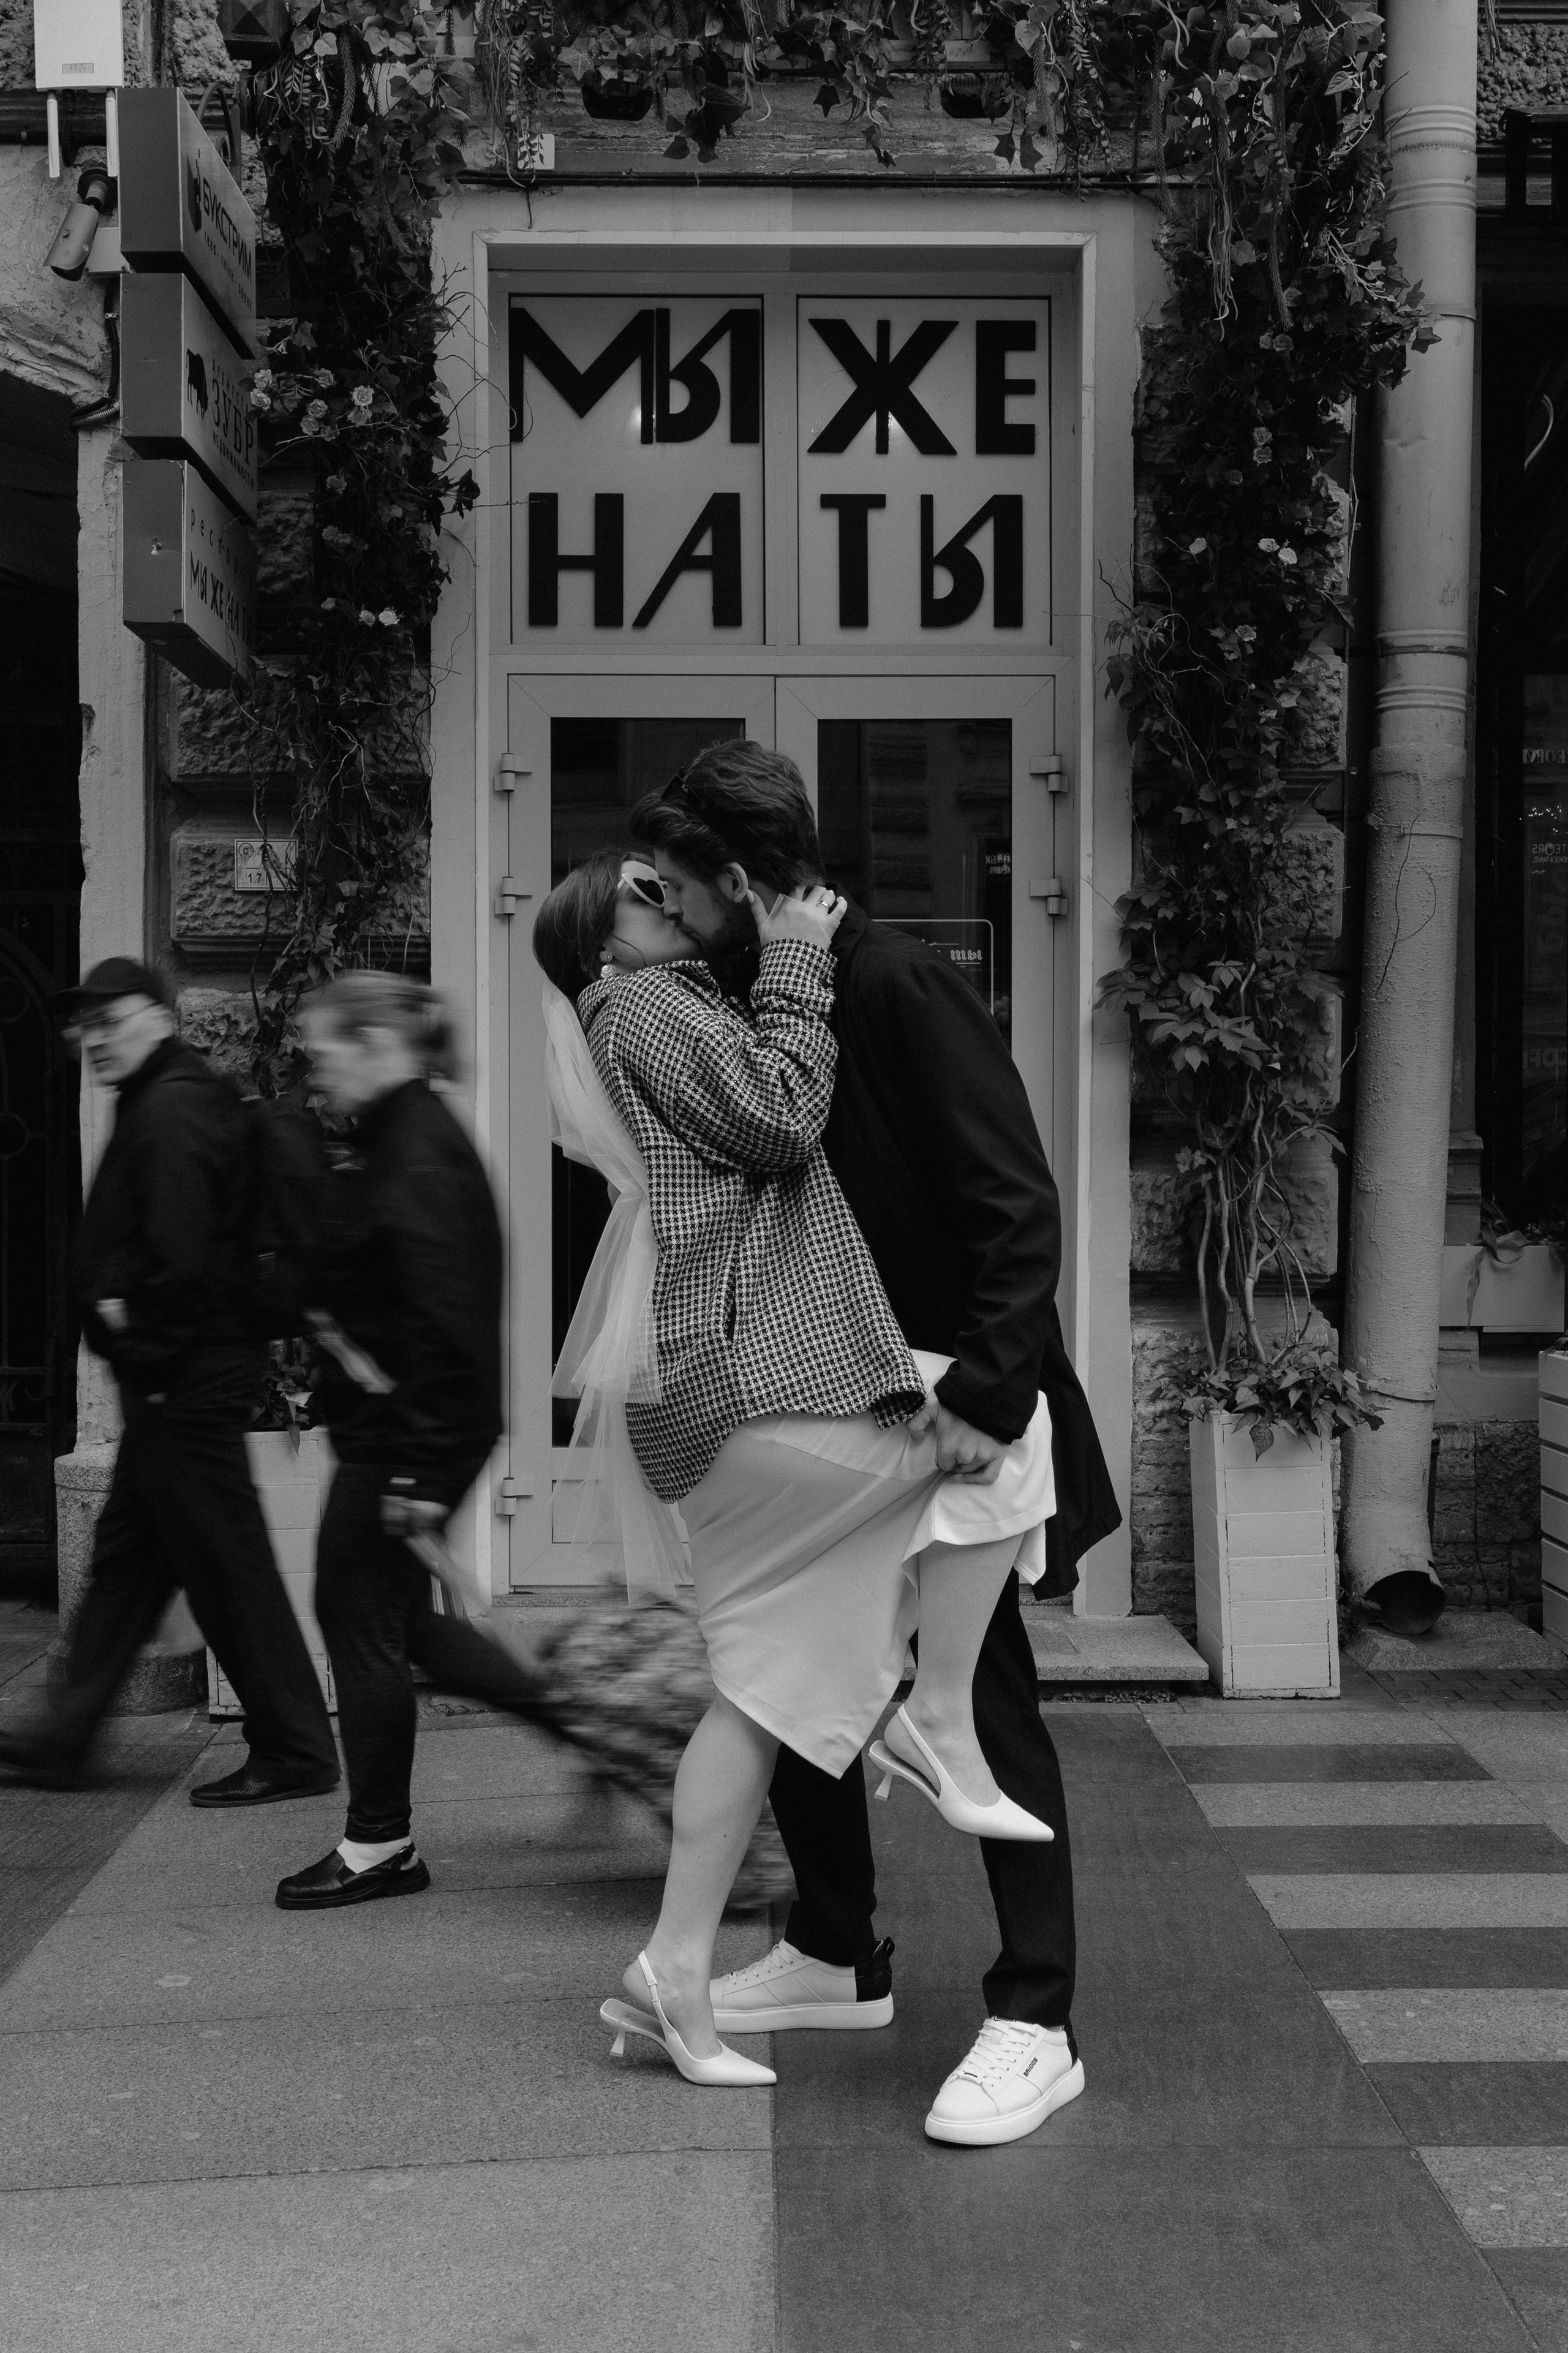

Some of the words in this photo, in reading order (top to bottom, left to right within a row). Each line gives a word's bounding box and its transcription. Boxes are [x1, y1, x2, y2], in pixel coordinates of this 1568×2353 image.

[203, 176, 252, 284] БУКСТРИМ
[212, 375, 254, 466] ЗУБР
[213, 358, 249, 415] АГЕНТСТВ
[510, 308, 760, 445] МЫ
[807, 319, 1036, 455] ЖЕ
[212, 429, 254, 491] НЕДВИЖИМОСТИ
[529, 493, 742, 629] НА
[820, 494, 1023, 630] ТЫ
